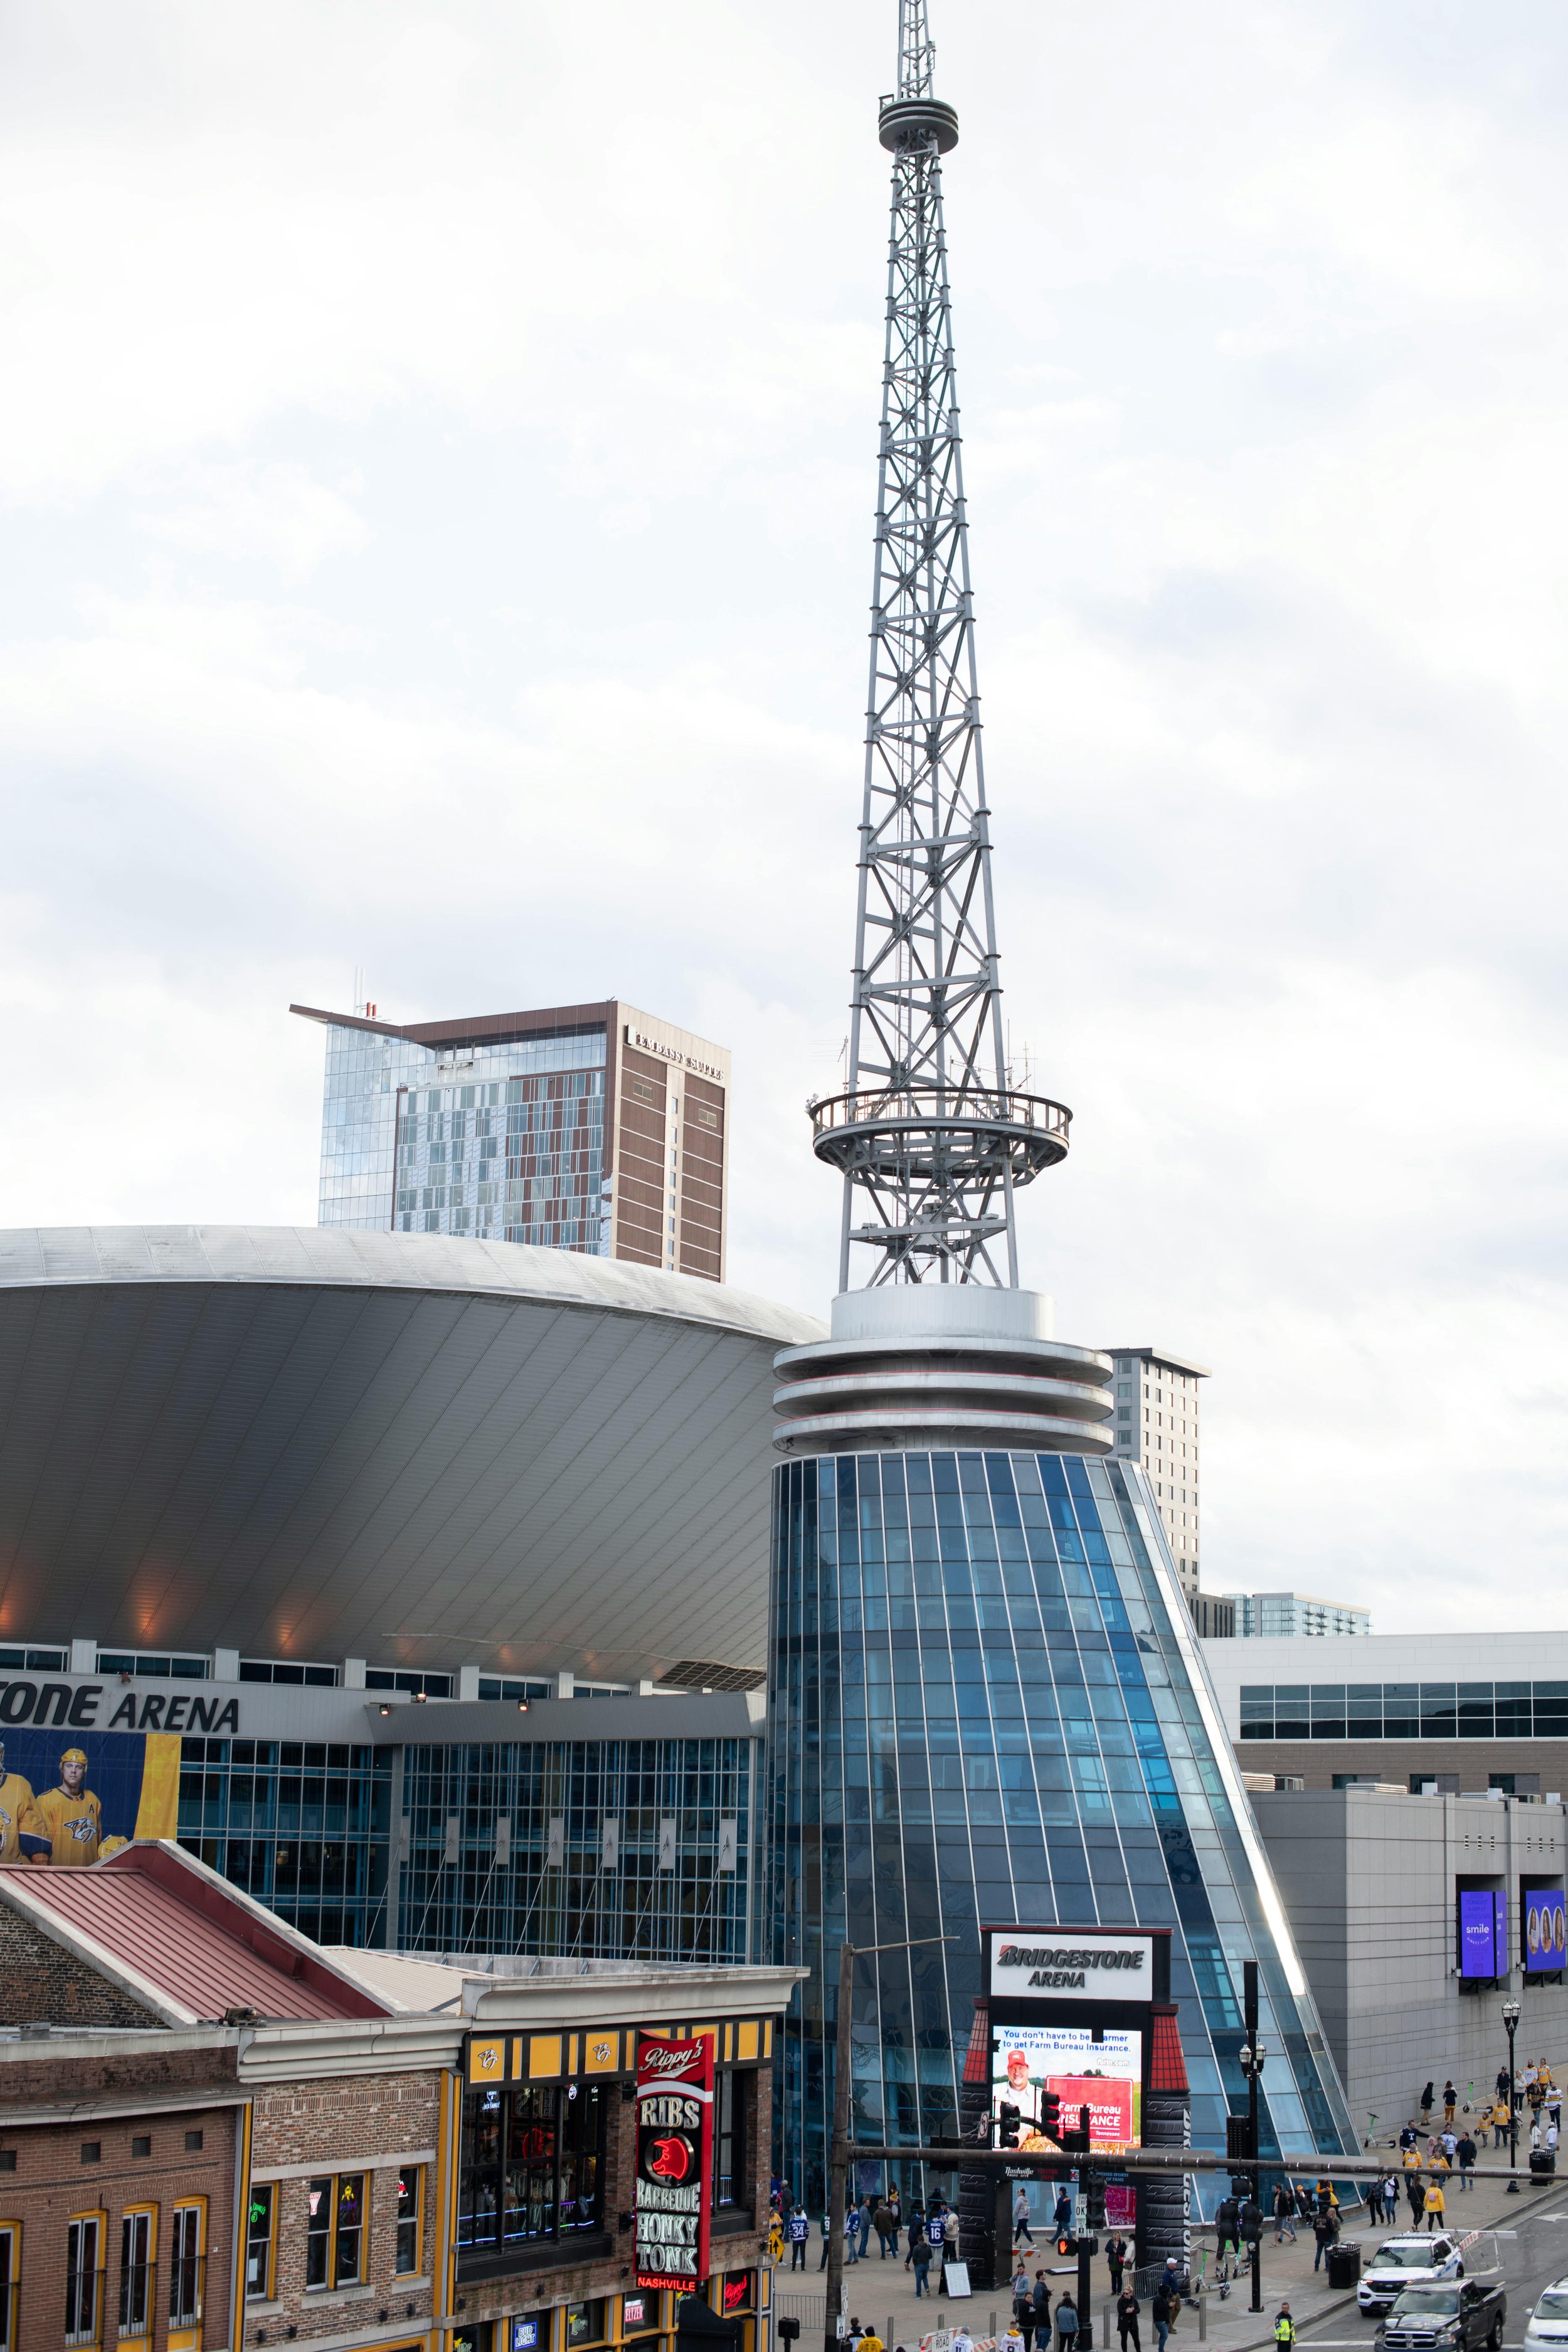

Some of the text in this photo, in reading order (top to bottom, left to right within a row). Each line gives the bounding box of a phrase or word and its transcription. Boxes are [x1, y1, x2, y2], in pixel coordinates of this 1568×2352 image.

[638, 1034, 724, 1079] EMBASSY SUITES
[0, 1682, 238, 1733] ONE ARENA
[1466, 1924, 1490, 1934] smile
[997, 1945, 1144, 1969] BRIDGESTONE
[1027, 1971, 1085, 1988] ARENA
[1004, 2030, 1020, 2038] You
[1080, 2032, 1090, 2040] be
[1014, 2041, 1027, 2049] get
[1054, 2042, 1084, 2050] Bureau
[1086, 2043, 1131, 2052] Insurance.
[639, 2038, 703, 2072] Rippy's
[640, 2096, 699, 2129] RIBS
[1059, 2101, 1083, 2112] Farm
[1057, 2113, 1120, 2126] INSUANCE
[1005, 2166, 1034, 2177] Nashville
[636, 2178, 701, 2213] BARBEQUE
[1076, 2206, 1085, 2215] OK
[636, 2212, 699, 2245] HONKY
[793, 2226, 804, 2237] 34
[931, 2227, 941, 2240] 16
[636, 2243, 697, 2275] TONK
[638, 2277, 696, 2292] NASHVILLE
[625, 2305, 643, 2322] ELTZER
[519, 2326, 533, 2338] BUD
[516, 2333, 535, 2347] LIGHT
[936, 2337, 950, 2349] ROAD
